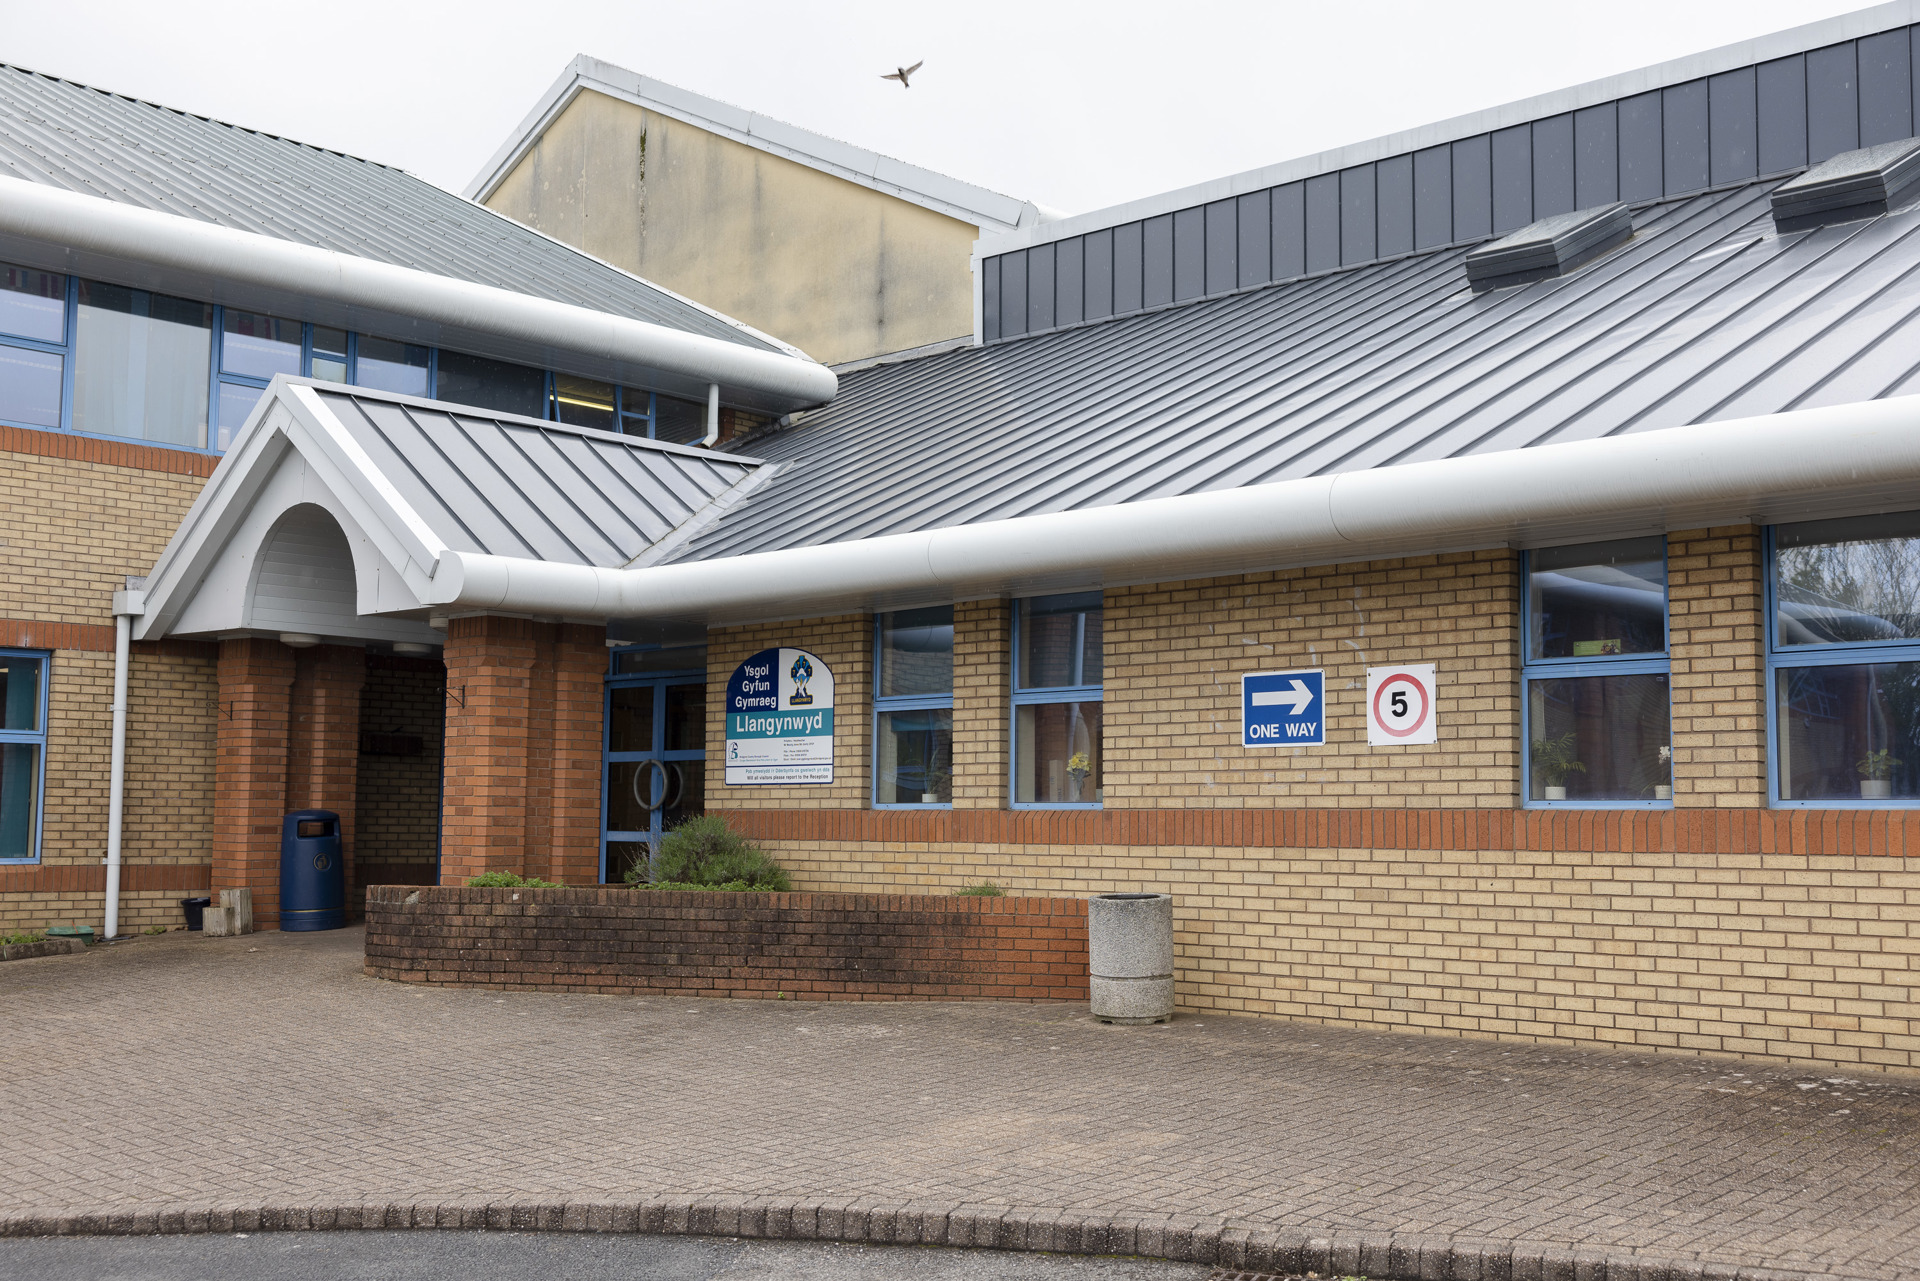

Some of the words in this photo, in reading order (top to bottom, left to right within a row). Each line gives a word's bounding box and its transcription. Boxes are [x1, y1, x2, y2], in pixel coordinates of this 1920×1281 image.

[744, 664, 769, 678] Ysgol
[742, 680, 770, 694] Gyfun
[735, 696, 777, 710] Gymraeg
[1391, 690, 1408, 717] 5
[736, 711, 822, 736] Llangynwyd
[1249, 723, 1280, 738] ONE
[1285, 722, 1317, 737] WAY
